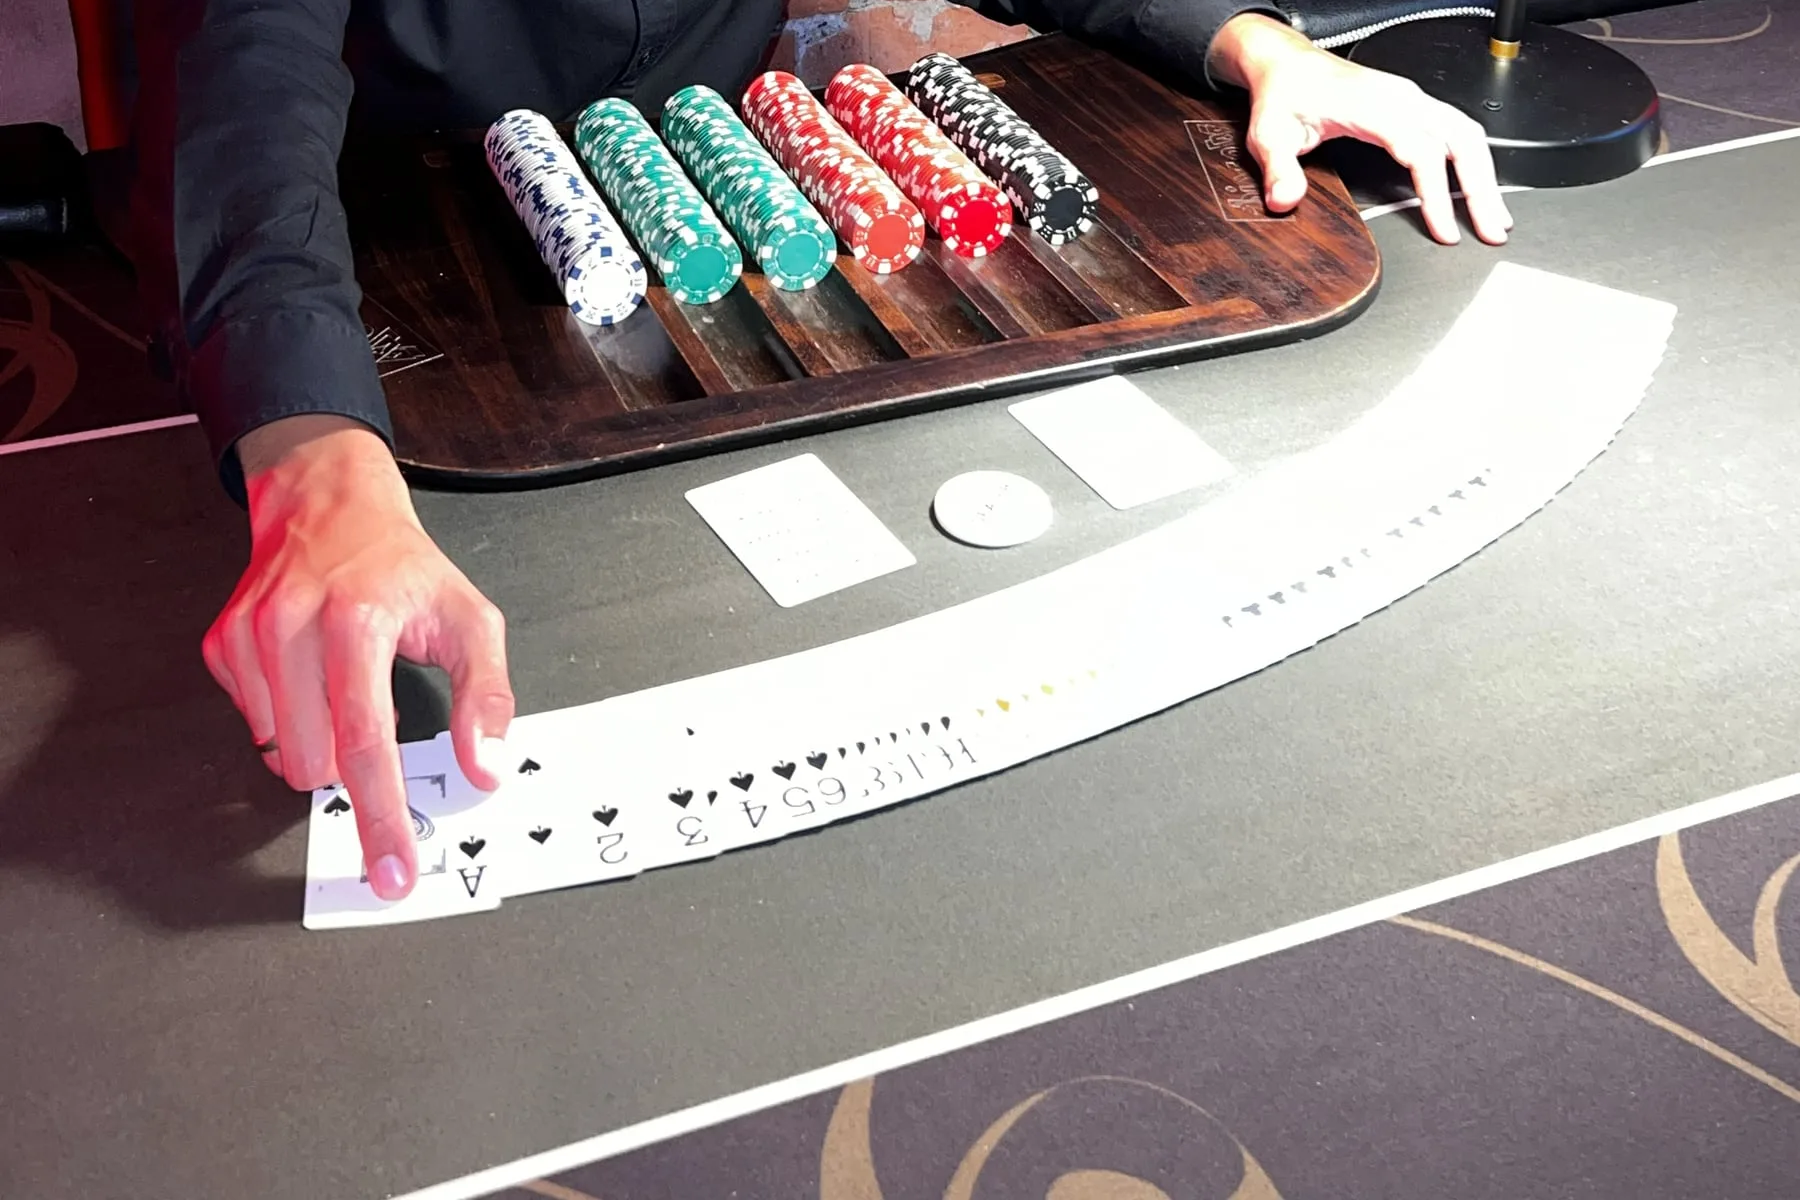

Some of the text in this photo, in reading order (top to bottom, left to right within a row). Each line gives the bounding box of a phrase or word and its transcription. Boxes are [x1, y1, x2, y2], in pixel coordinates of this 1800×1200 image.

[783, 787, 816, 817] 5
[818, 778, 847, 806] 6
[740, 800, 768, 828] 4
[677, 816, 709, 846] 3
[597, 832, 628, 865] 2
[457, 865, 487, 898] A
